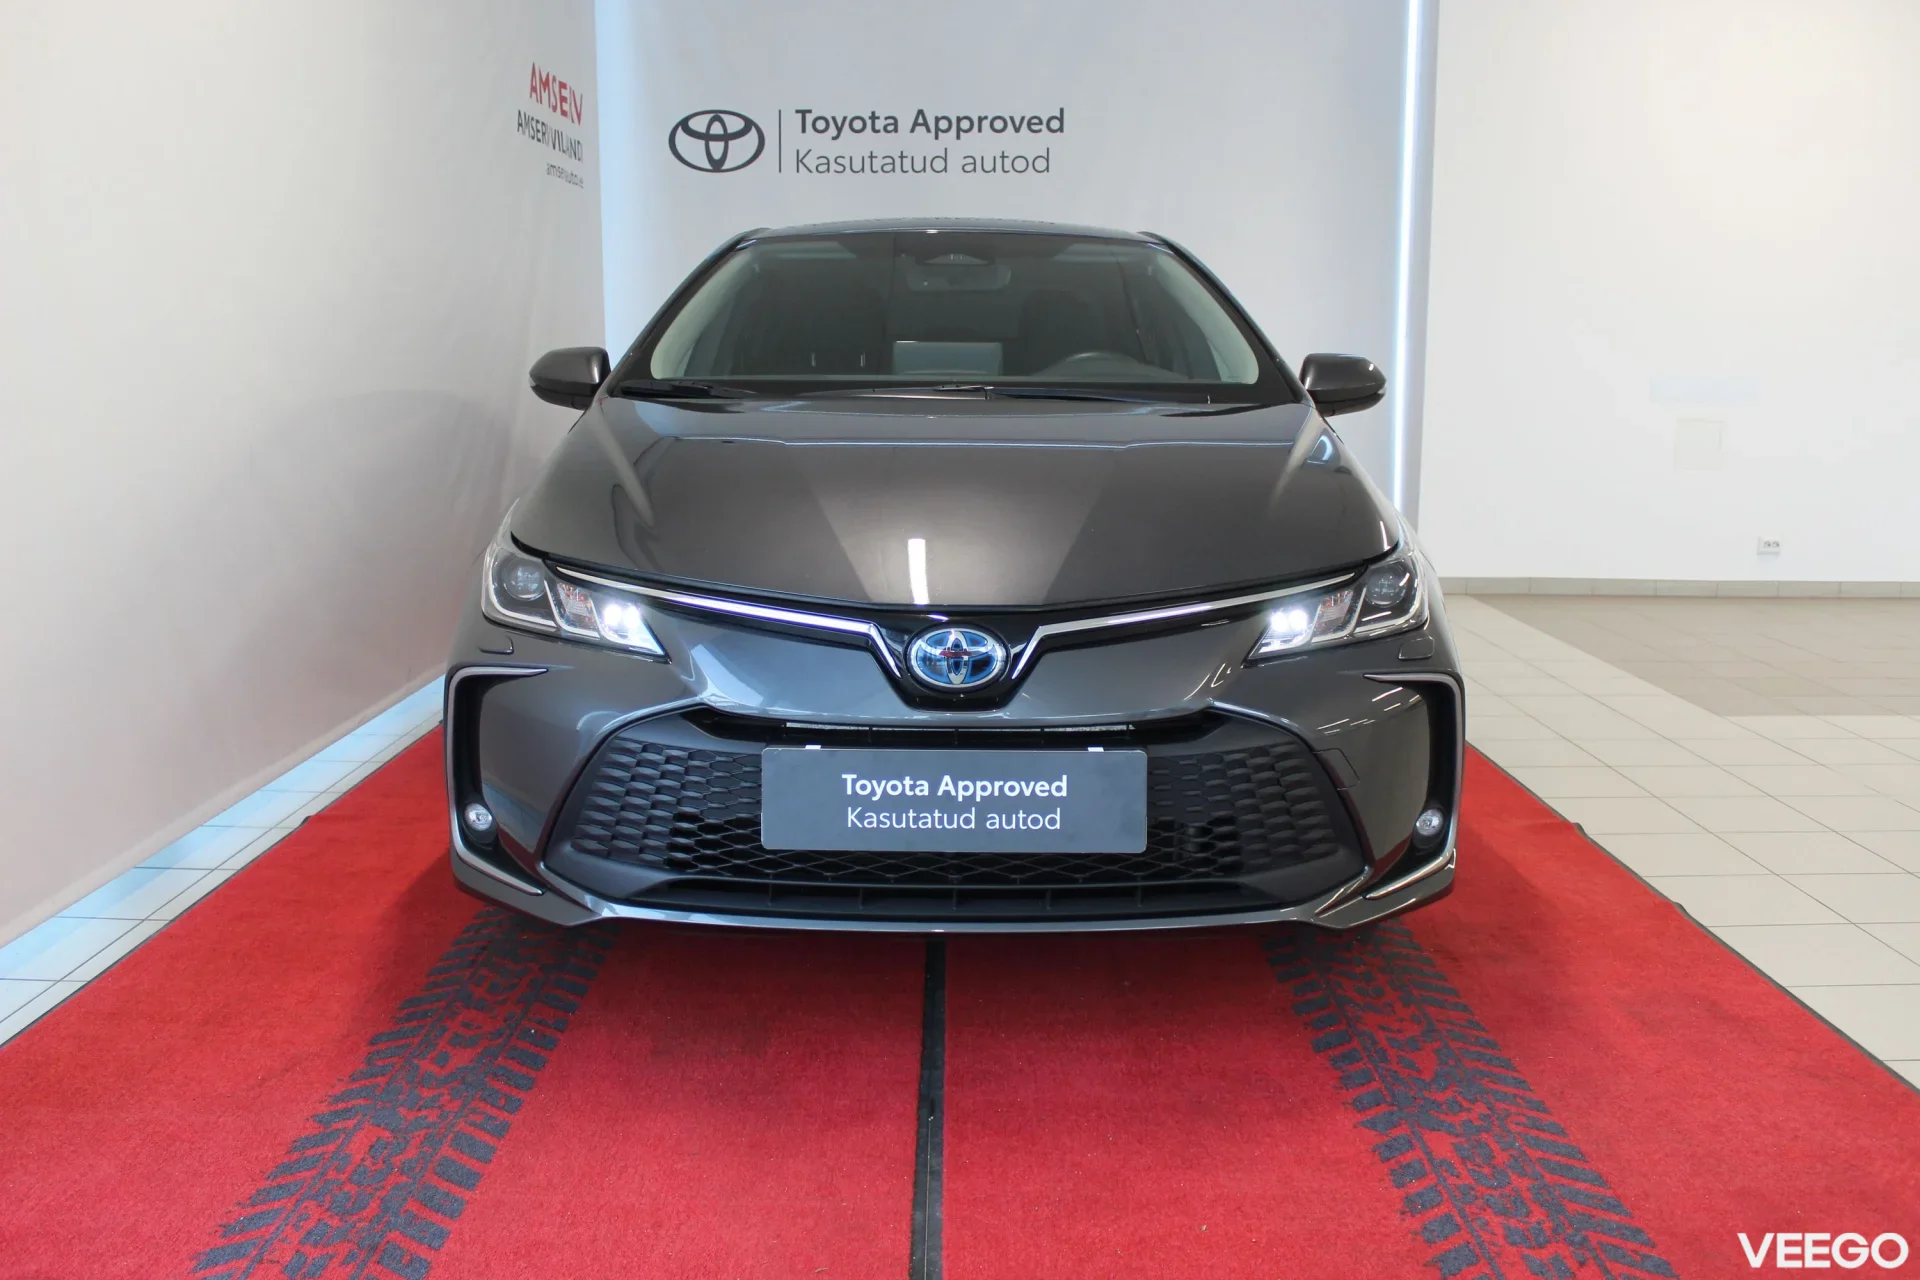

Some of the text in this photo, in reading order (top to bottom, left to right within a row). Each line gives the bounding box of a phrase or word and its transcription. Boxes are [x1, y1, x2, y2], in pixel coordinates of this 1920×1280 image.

[795, 107, 1065, 140] Toyota Approved
[795, 147, 1050, 174] Kasutatud autod
[842, 774, 1068, 802] Toyota Approved
[847, 807, 1061, 830] Kasutatud autod
